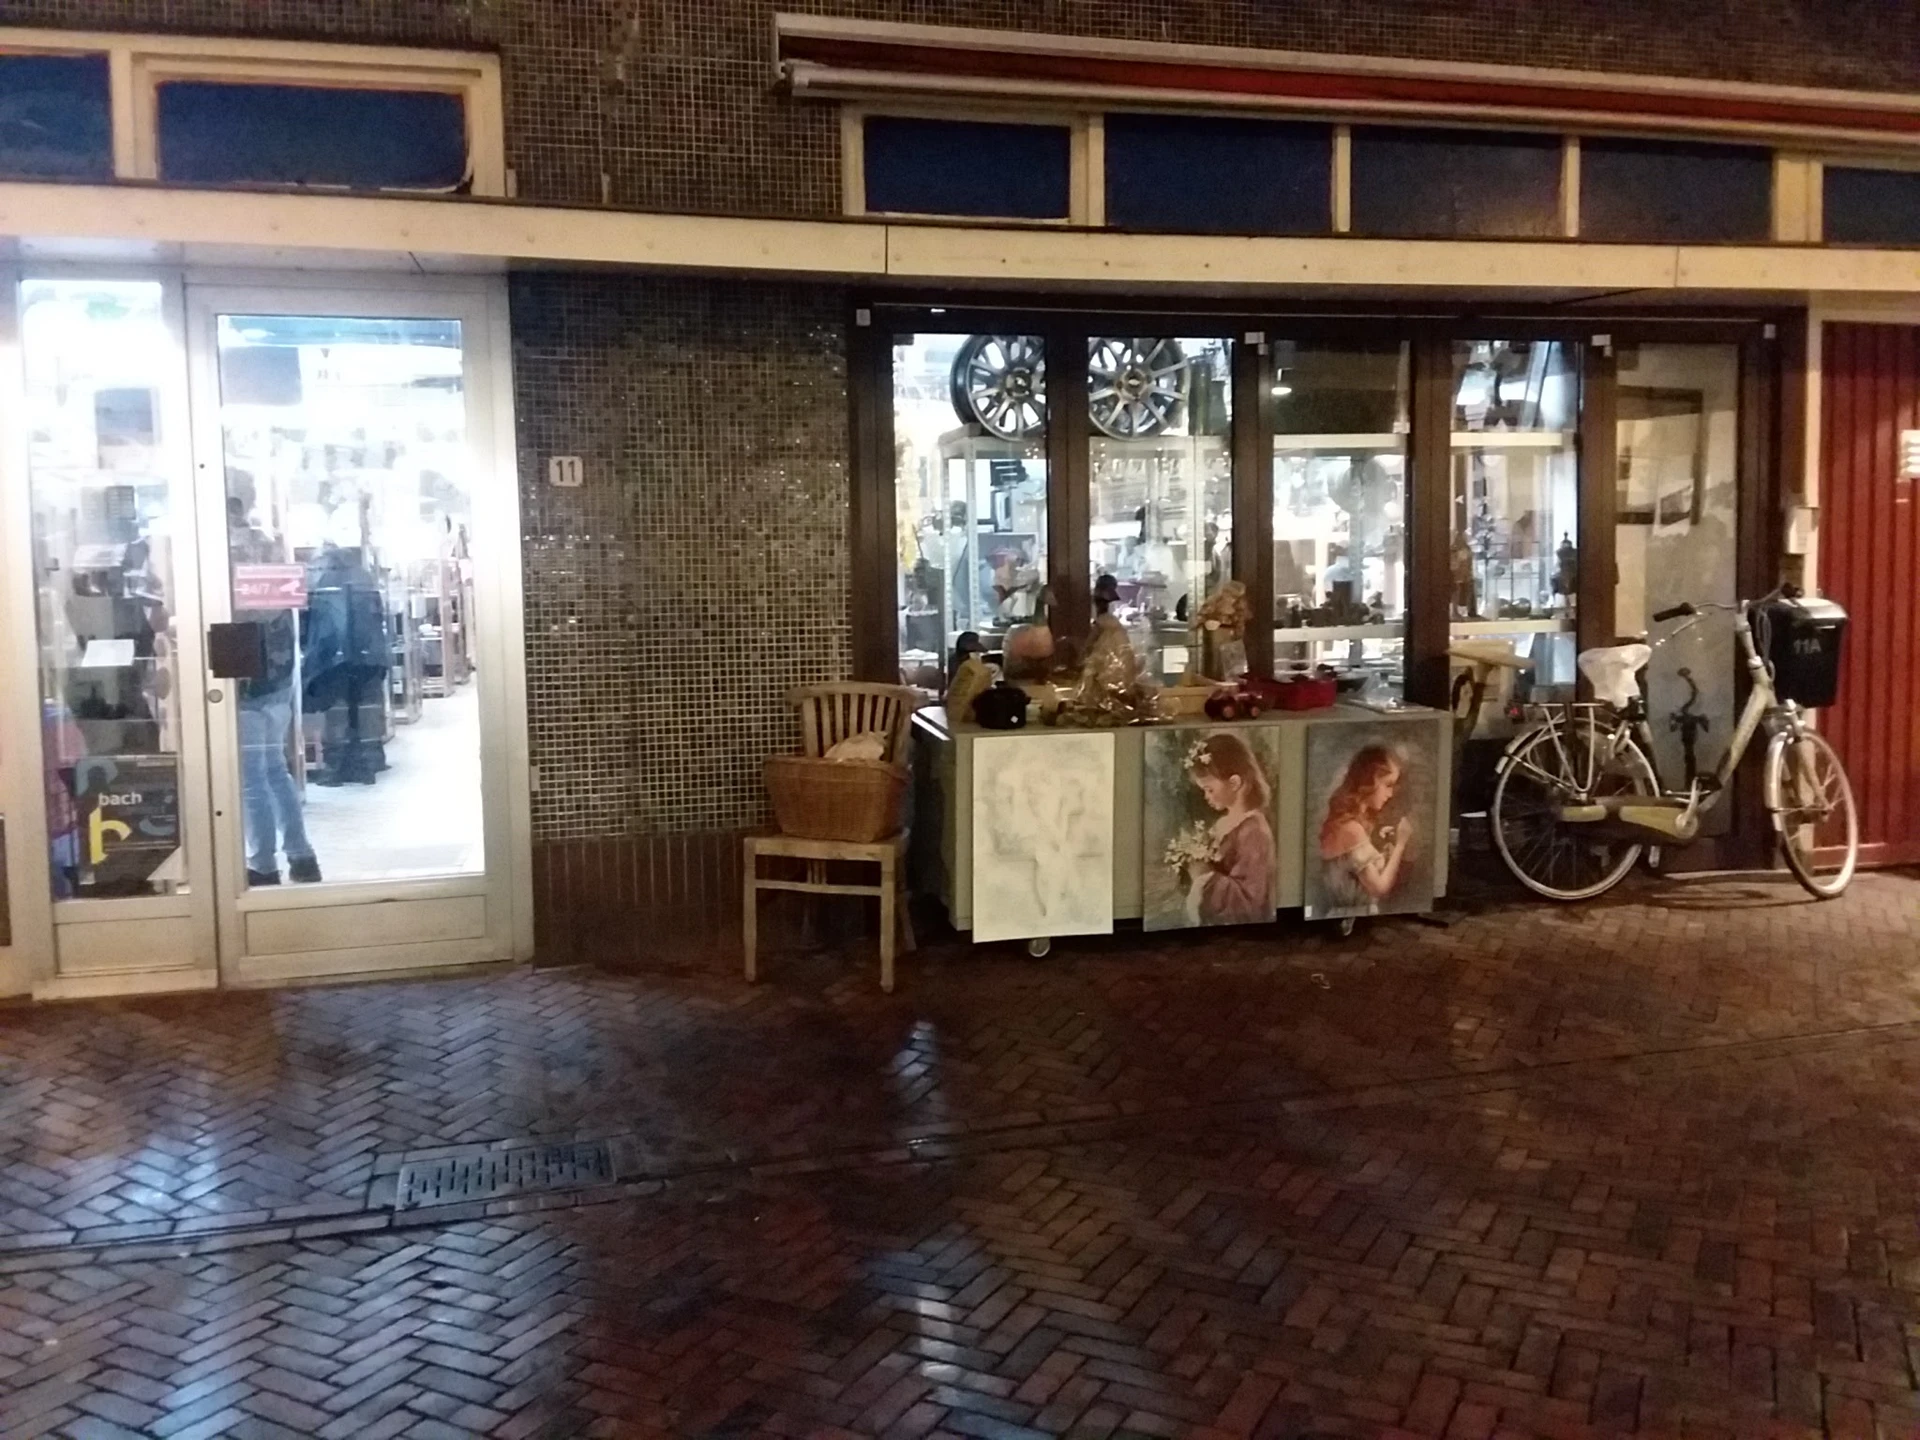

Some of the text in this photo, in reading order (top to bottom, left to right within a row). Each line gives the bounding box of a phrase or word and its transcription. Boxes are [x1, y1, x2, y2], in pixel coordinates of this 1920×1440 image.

[555, 459, 576, 483] 11
[1793, 638, 1822, 655] 11A
[98, 791, 143, 806] bach
